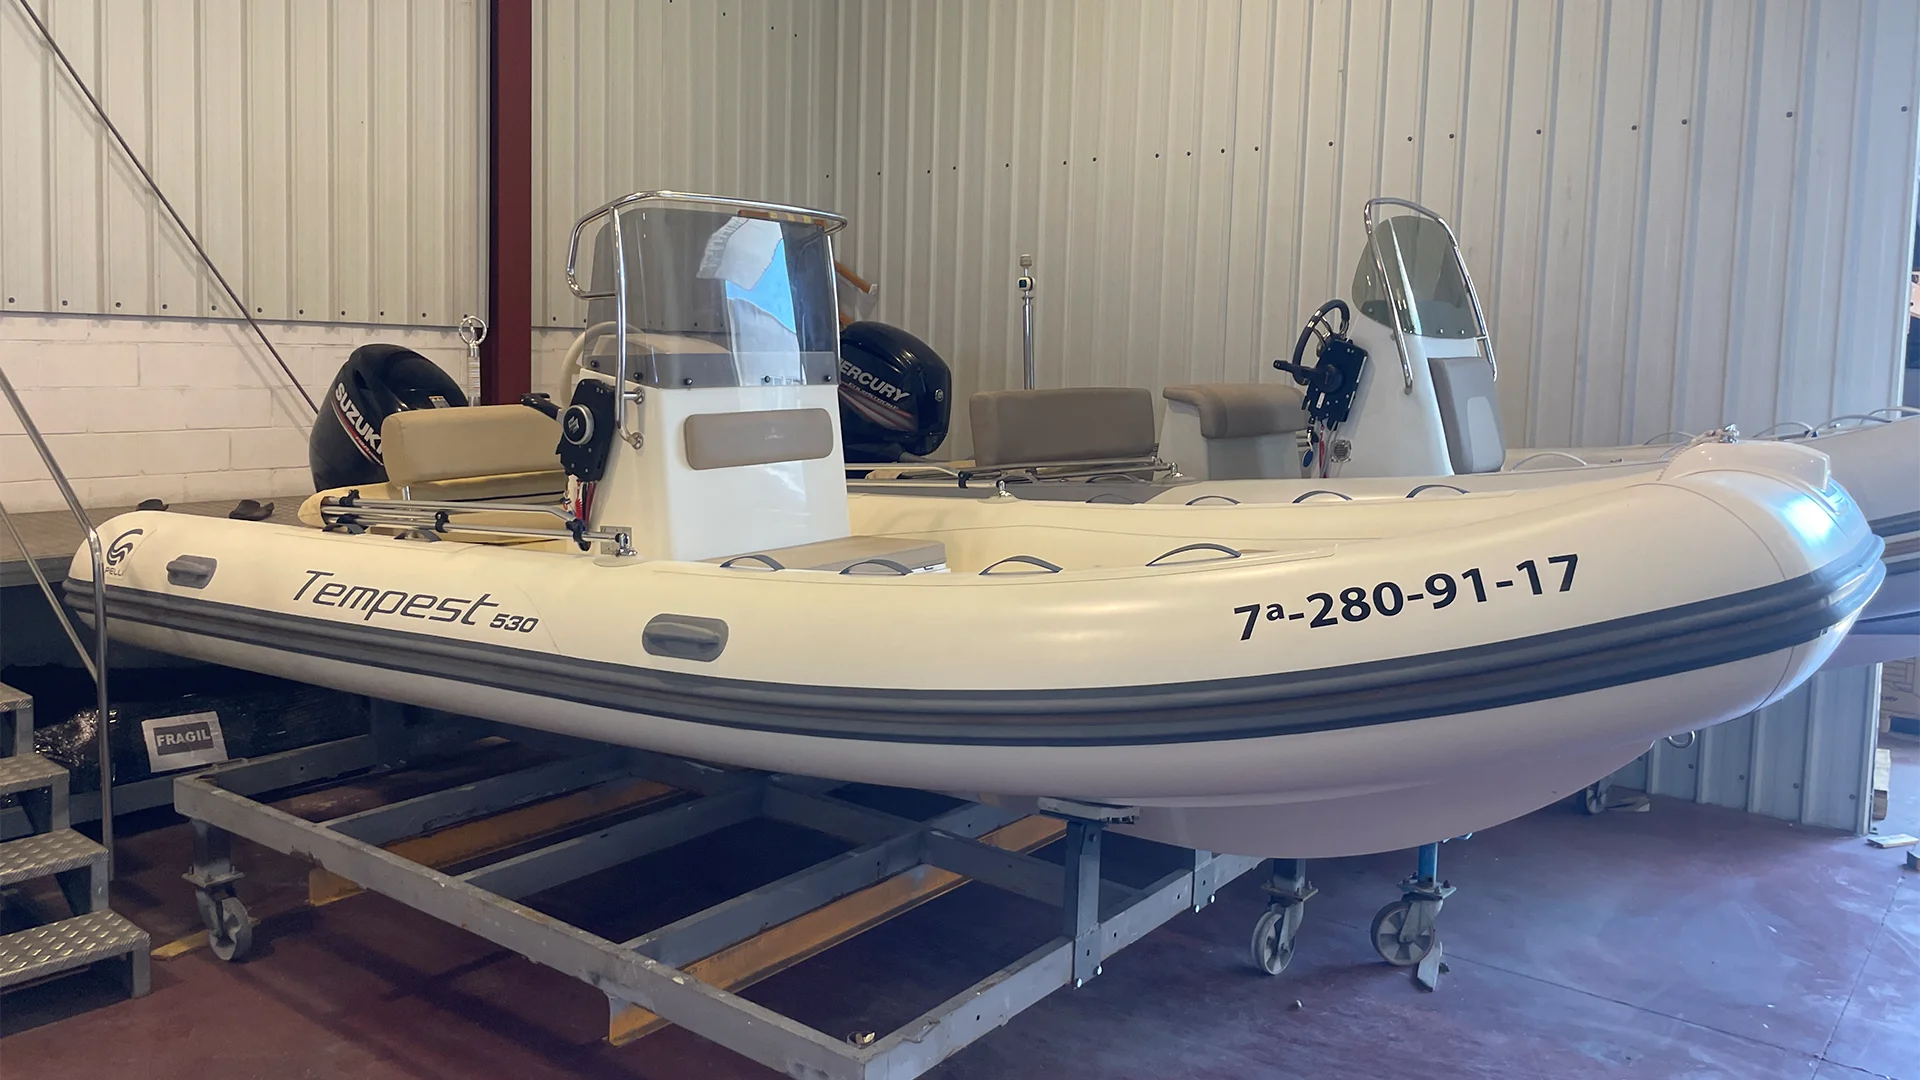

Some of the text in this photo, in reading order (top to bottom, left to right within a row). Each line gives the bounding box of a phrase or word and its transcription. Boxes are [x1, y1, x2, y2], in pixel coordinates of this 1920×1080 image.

[839, 357, 911, 402] ERCURY
[292, 569, 540, 634] Tempest 530
[156, 729, 211, 747] FRAGIL
